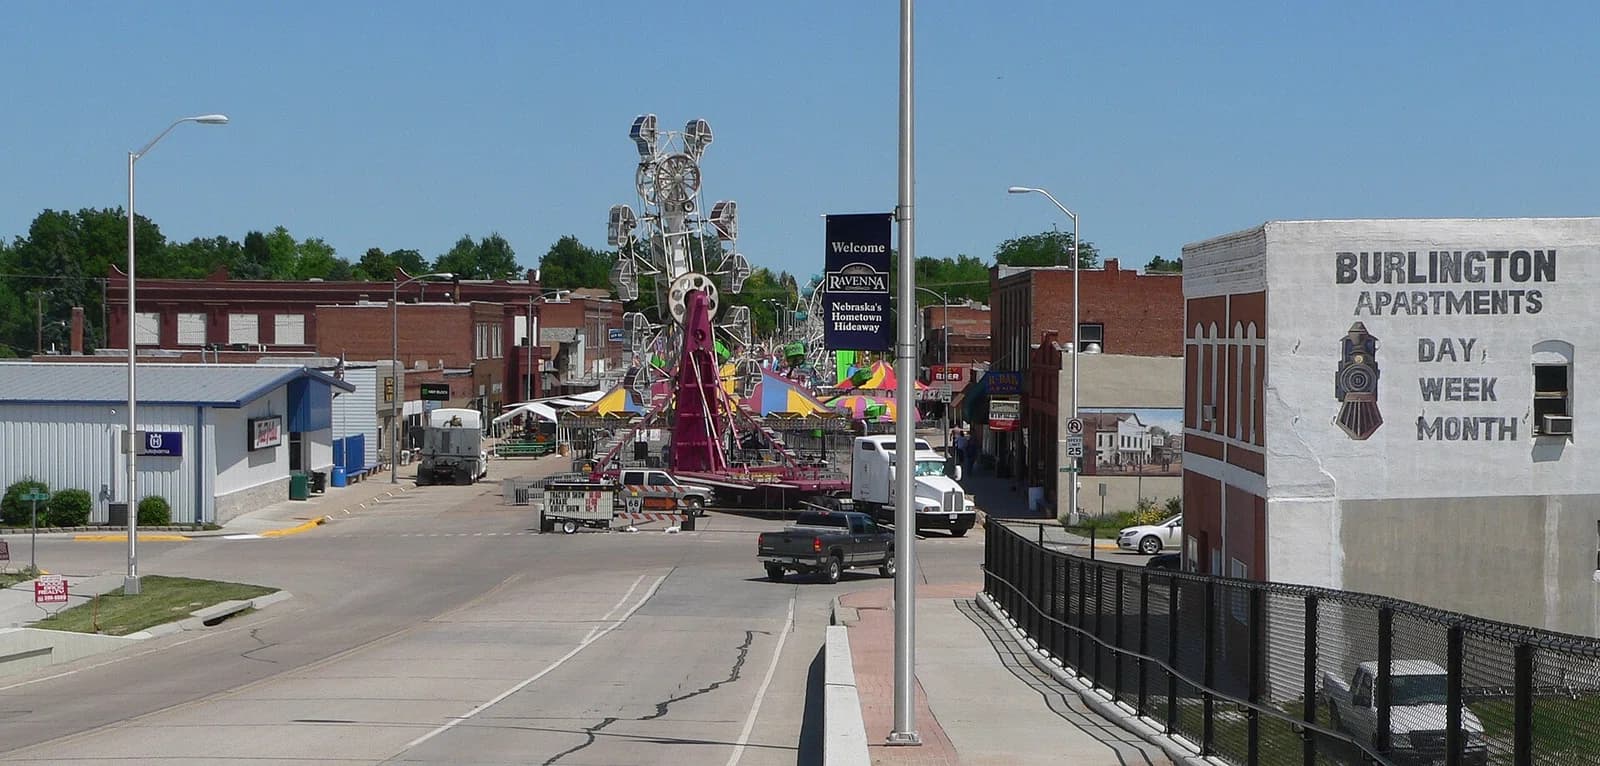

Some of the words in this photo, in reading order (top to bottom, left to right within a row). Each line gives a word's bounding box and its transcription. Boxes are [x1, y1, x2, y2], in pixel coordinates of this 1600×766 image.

[832, 242, 885, 253] Welcome
[1335, 250, 1556, 284] BURLINGTON
[830, 276, 885, 290] RAVENNA
[832, 302, 882, 311] Nebraska's
[1354, 289, 1543, 316] APARTMENTS
[832, 312, 882, 322] Hometown
[834, 322, 880, 333] Hideaway
[1419, 377, 1498, 402] WEEK
[1416, 416, 1517, 441] MONTH
[1068, 447, 1082, 456] 25
